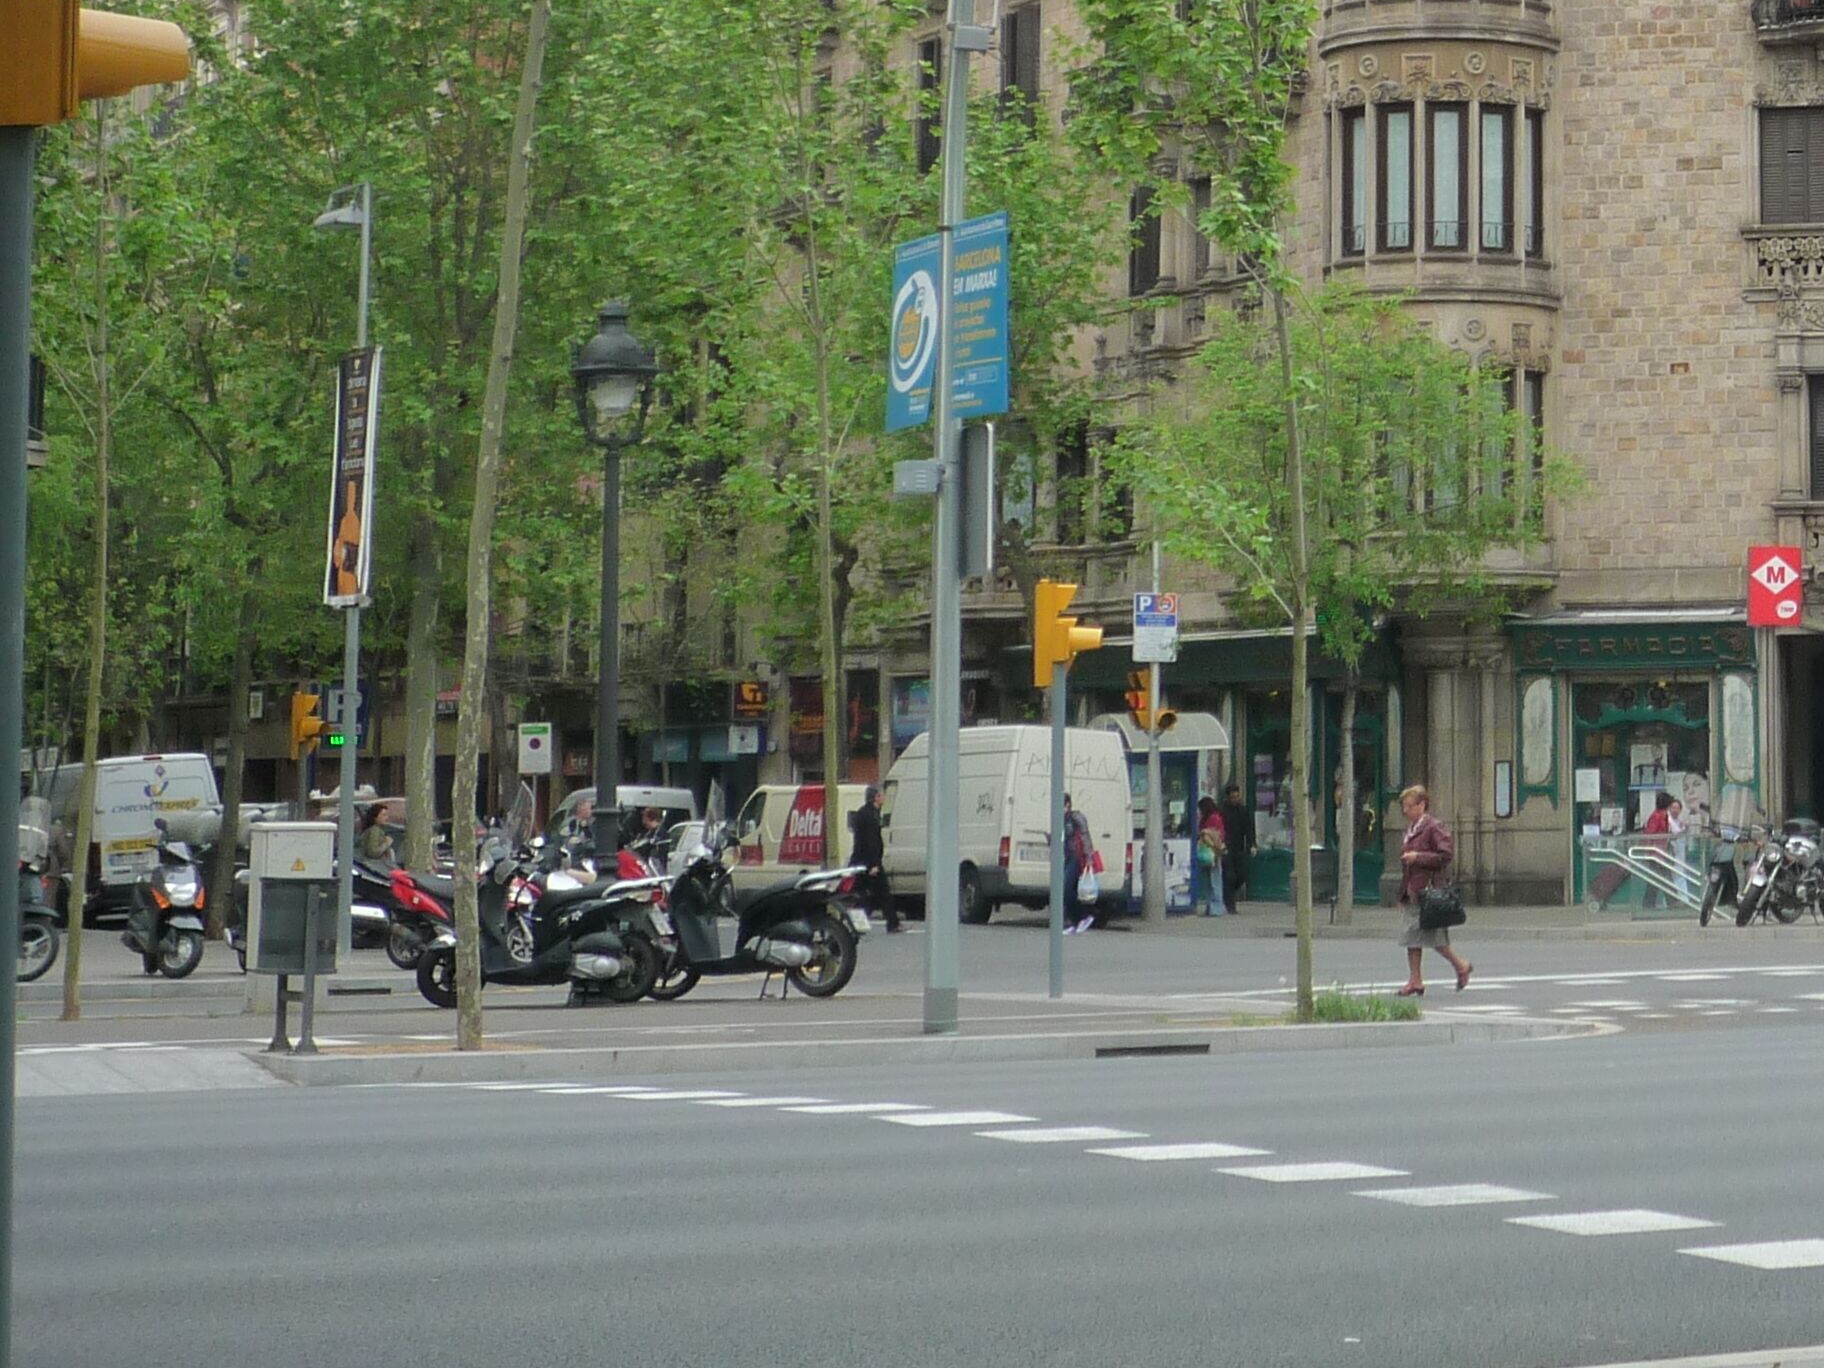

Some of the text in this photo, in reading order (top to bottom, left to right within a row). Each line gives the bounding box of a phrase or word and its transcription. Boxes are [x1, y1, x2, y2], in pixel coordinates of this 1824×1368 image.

[1766, 566, 1786, 584] M
[1140, 596, 1152, 612] P
[1554, 634, 1716, 657] FARMACIA
[789, 806, 823, 839] Delta
